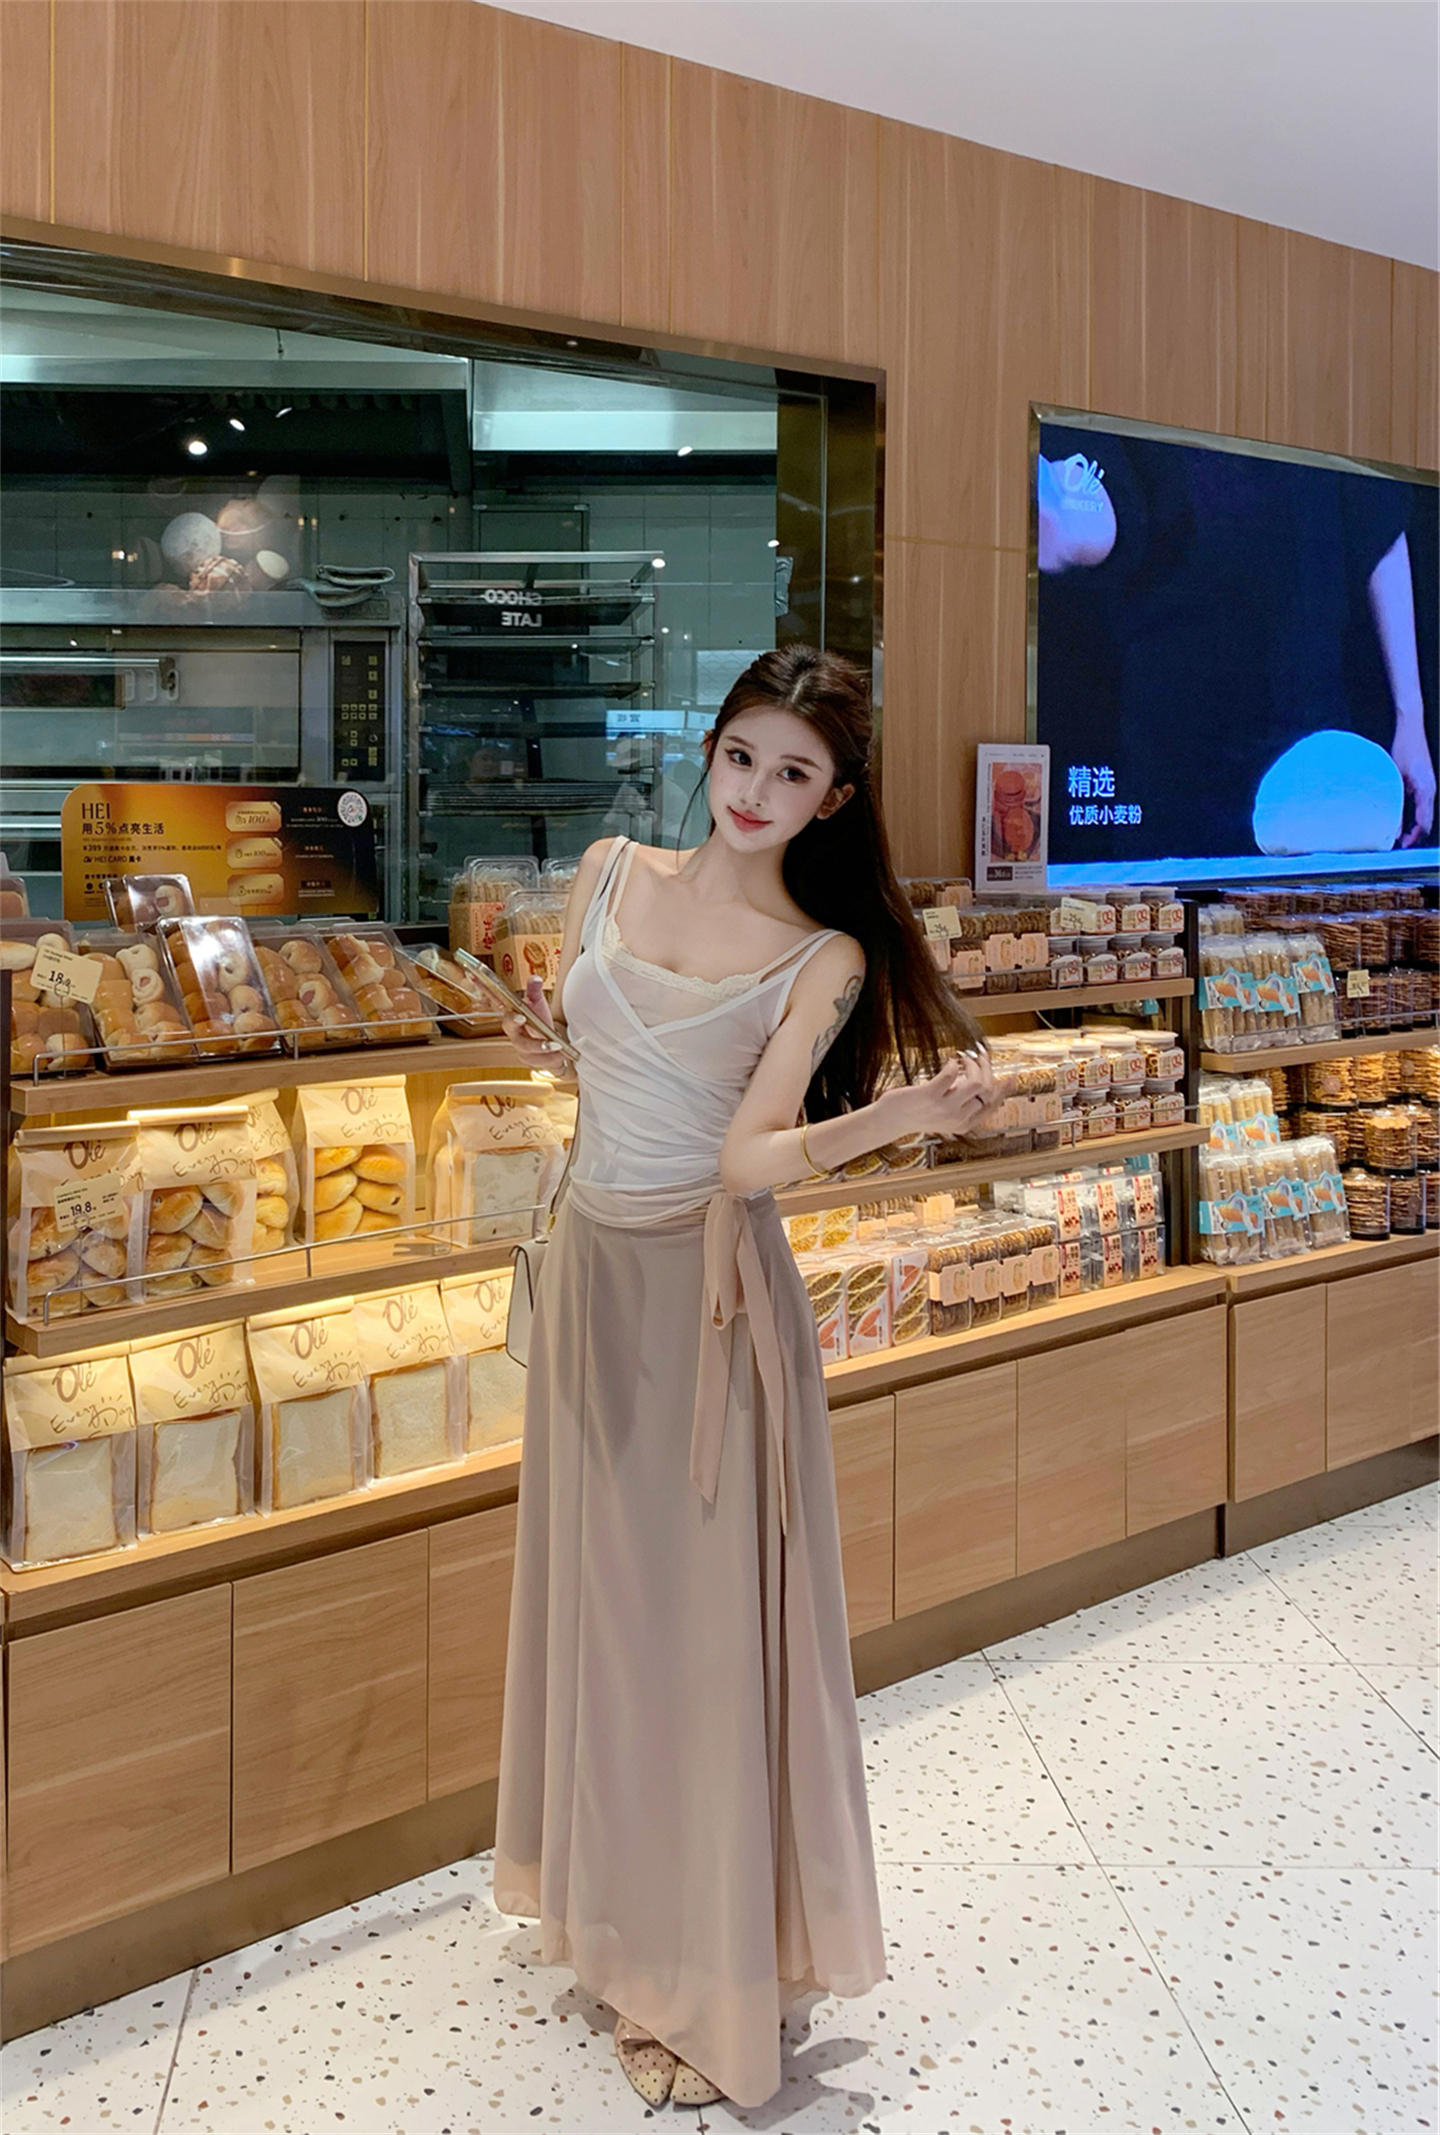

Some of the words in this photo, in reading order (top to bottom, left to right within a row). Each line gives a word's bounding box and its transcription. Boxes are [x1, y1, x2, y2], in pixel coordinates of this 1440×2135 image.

[1064, 453, 1105, 495] Olé
[1068, 765, 1115, 798] 精选
[82, 803, 110, 819] HEI
[1069, 804, 1142, 825] 优质小麦粉
[82, 821, 164, 836] 用5%点亮生活
[341, 1086, 380, 1116] Olé
[173, 1122, 217, 1152] Olé
[341, 1117, 381, 1139] Every
[63, 1140, 107, 1170] Olé
[173, 1154, 220, 1177] Every
[210, 1158, 256, 1177] Day
[70, 1200, 92, 1217] 19.8
[383, 1293, 418, 1333] Olé
[290, 1317, 329, 1360] Olé
[386, 1332, 424, 1360] Every
[174, 1336, 215, 1379] Olé
[326, 1360, 364, 1383] Day
[51, 1361, 97, 1403] Olé
[292, 1358, 333, 1388] Every
[173, 1379, 217, 1409] Every
[210, 1381, 251, 1404] Day
[50, 1403, 99, 1434] Every
[89, 1406, 136, 1429] Day
